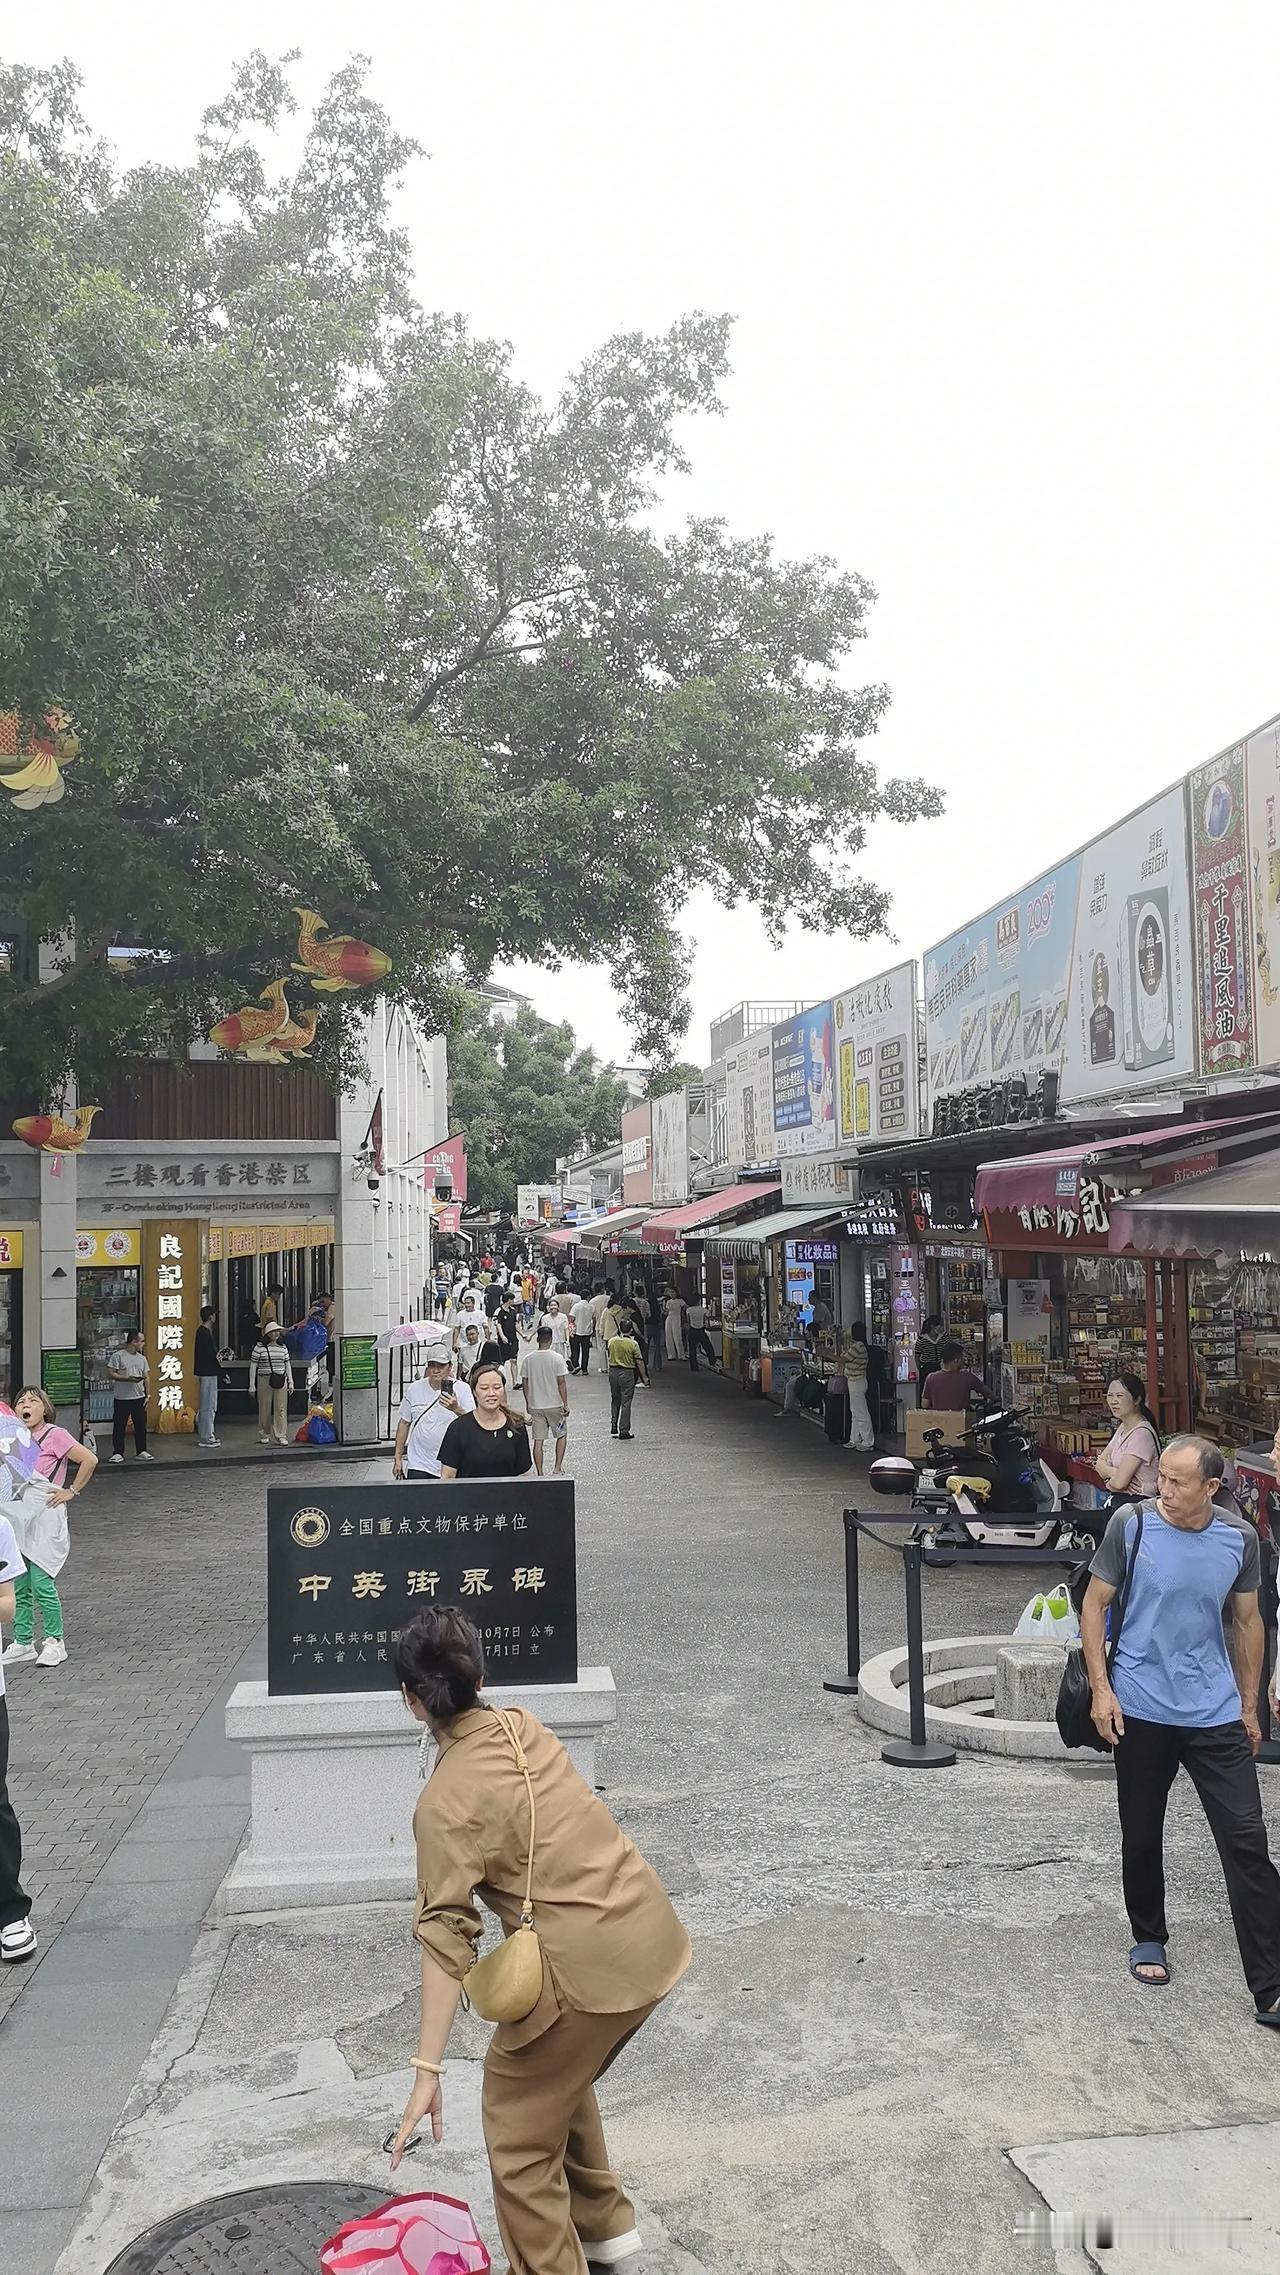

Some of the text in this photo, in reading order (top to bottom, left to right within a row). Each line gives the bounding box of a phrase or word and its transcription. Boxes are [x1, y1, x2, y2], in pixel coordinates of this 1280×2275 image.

[1212, 884, 1234, 1039] 千里追風油
[104, 1162, 312, 1188] 三楼观看香港禁区
[338, 1512, 528, 1537] 全国重点文物保护单位
[297, 1566, 546, 1602] 中英街界碑
[529, 1643, 541, 1656] 立
